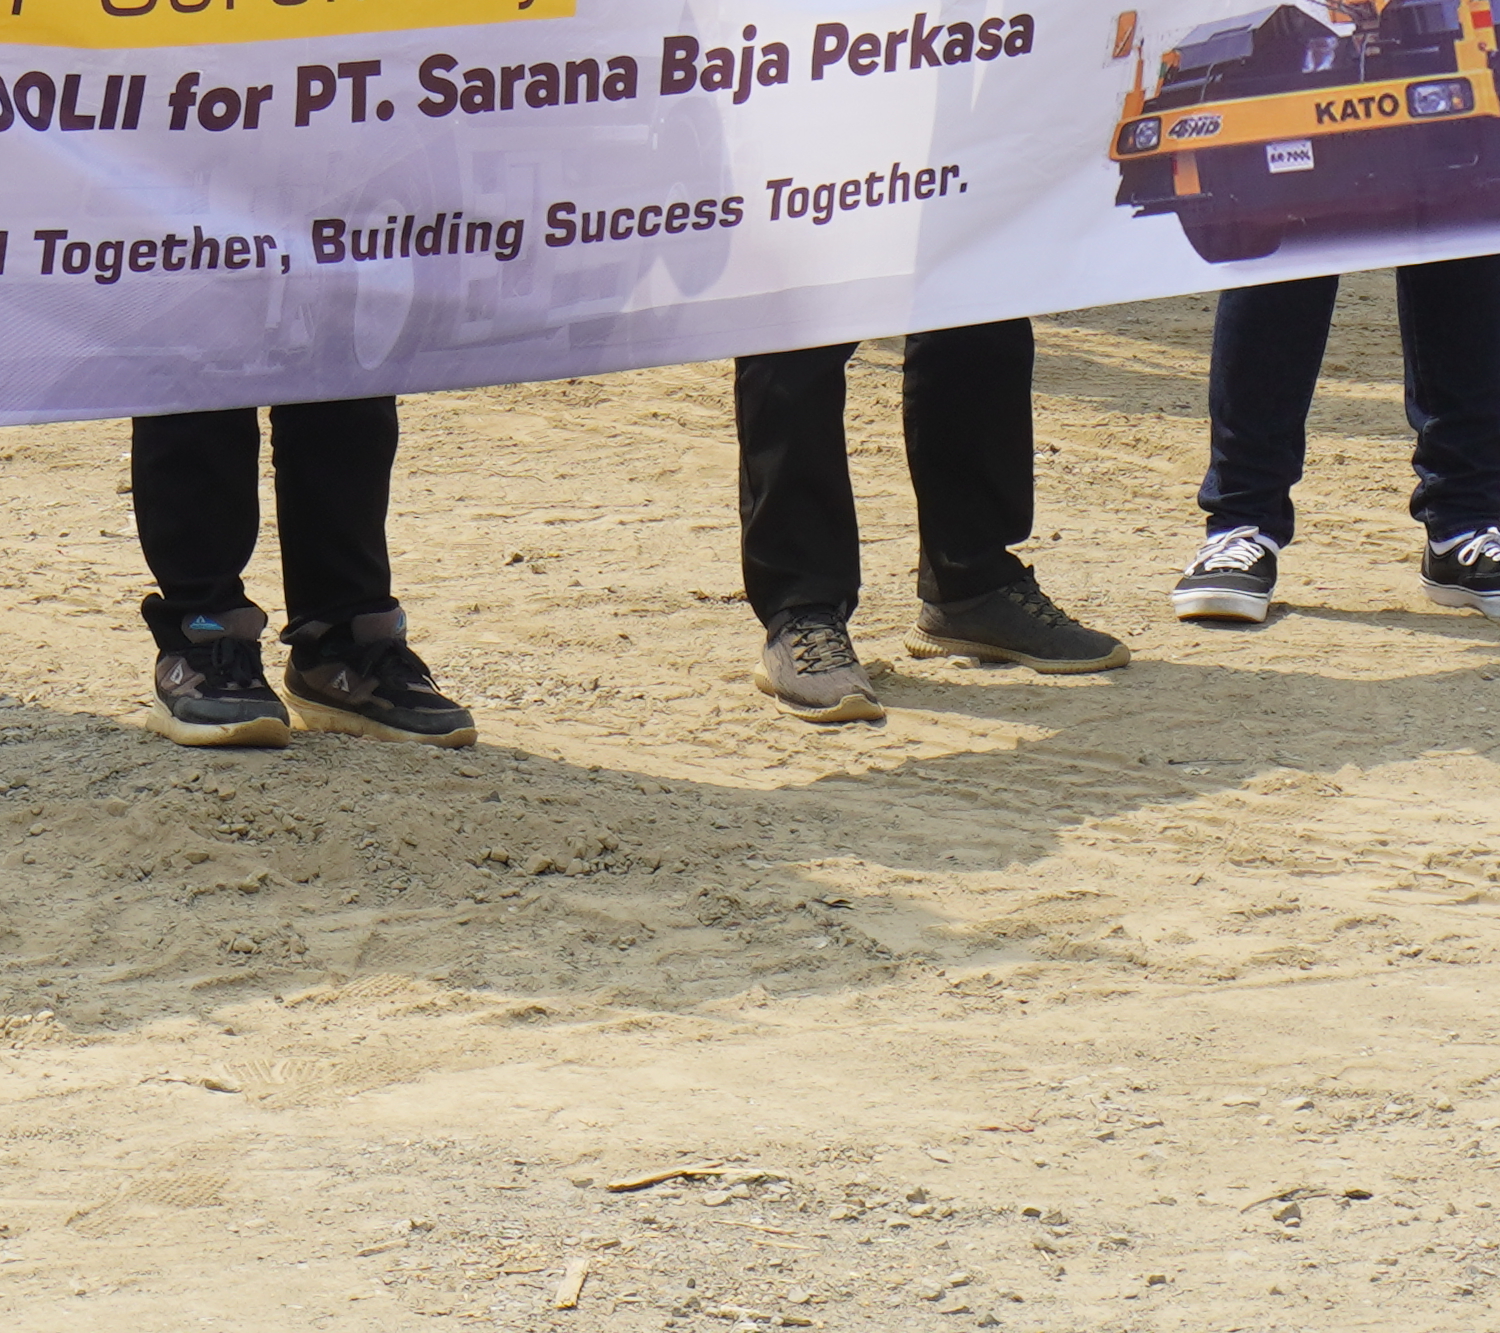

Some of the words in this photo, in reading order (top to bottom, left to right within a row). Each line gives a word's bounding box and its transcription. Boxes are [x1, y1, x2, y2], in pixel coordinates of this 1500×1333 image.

[168, 70, 273, 132] for
[295, 60, 396, 127] PT.
[418, 53, 634, 120] Sarana
[660, 35, 790, 105] Baja
[810, 12, 1036, 82] Perkasa
[1314, 92, 1400, 125] KATO
[36, 226, 292, 279] Together,
[311, 209, 525, 266] Building
[545, 190, 743, 247] Success
[766, 158, 969, 228] Together.
